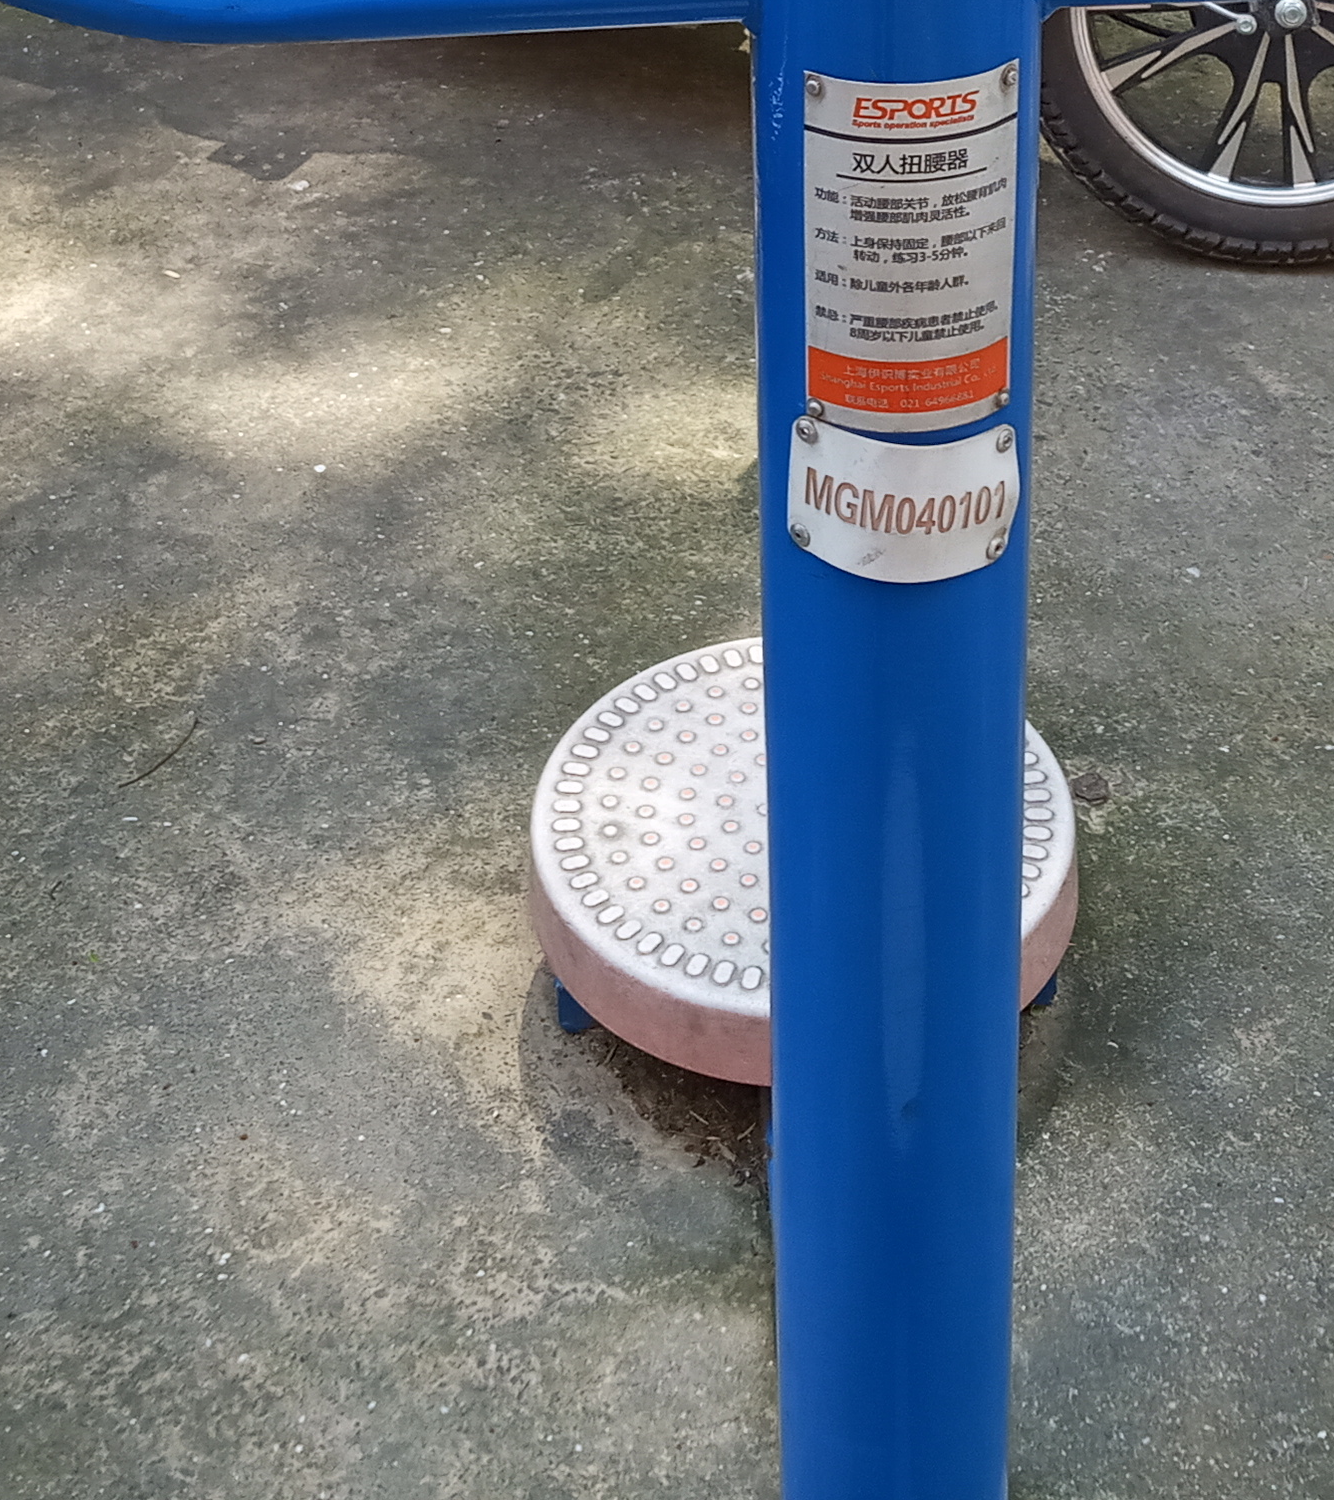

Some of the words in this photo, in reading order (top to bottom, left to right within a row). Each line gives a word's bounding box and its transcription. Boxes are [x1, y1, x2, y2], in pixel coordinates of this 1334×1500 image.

[852, 90, 980, 120] ESPORTS
[851, 119, 882, 130] Sports
[852, 148, 969, 175] 双人扭腰器
[804, 466, 1006, 535] MGM040101
